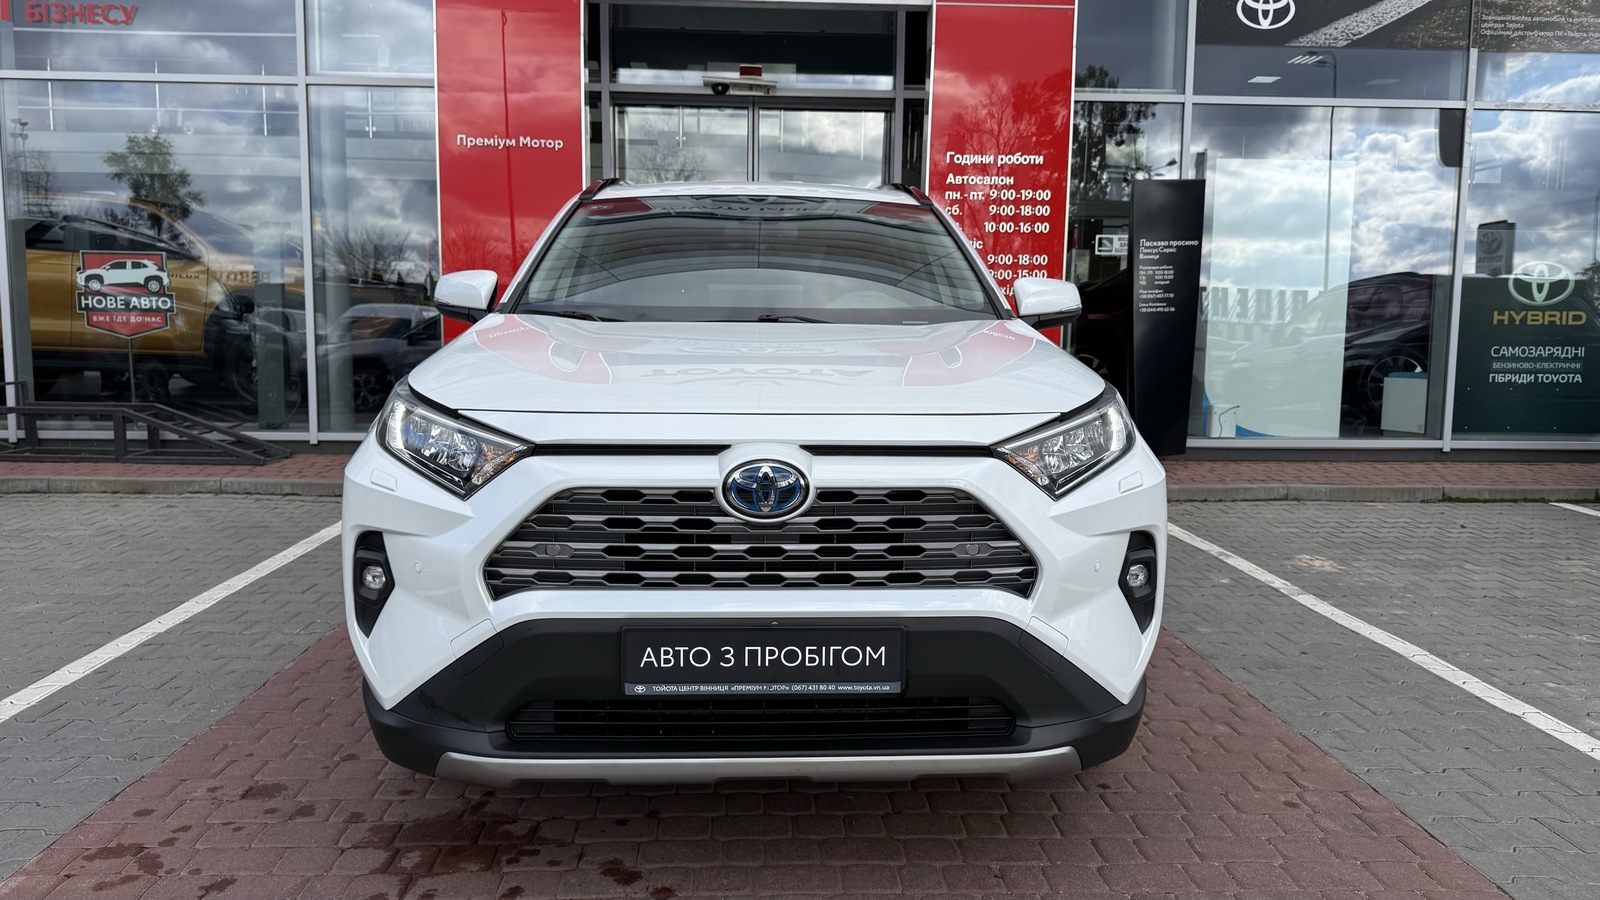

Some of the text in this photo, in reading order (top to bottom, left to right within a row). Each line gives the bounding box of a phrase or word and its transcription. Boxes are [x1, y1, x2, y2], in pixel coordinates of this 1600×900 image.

[25, 1, 137, 25] БІЗНЕСУ
[457, 134, 564, 151] Преміум Мотор
[946, 151, 1044, 167] Години роботи
[945, 173, 1014, 185] Автосалон
[989, 189, 1052, 201] 9:00-19:00
[945, 204, 1051, 217] сб. 9:00-18:00
[983, 222, 1050, 234] 10:00-16:00
[1140, 239, 1199, 248] Ласкаво просимо
[987, 254, 1048, 266] 9:00-18:00
[81, 295, 172, 310] НОВЕ АВТО
[92, 314, 163, 324] ВЖЕ ЇДЕ ДО НАС
[1492, 310, 1588, 326] HYBRID
[1491, 346, 1585, 358] САМОЗАРЯДНІ
[1489, 373, 1583, 384] ГІБРИДИ TOYOTA
[640, 645, 886, 668] АВТО З ПРОБІГОМ
[678, 685, 699, 693] ЦЕНТР
[791, 684, 808, 692] (067)
